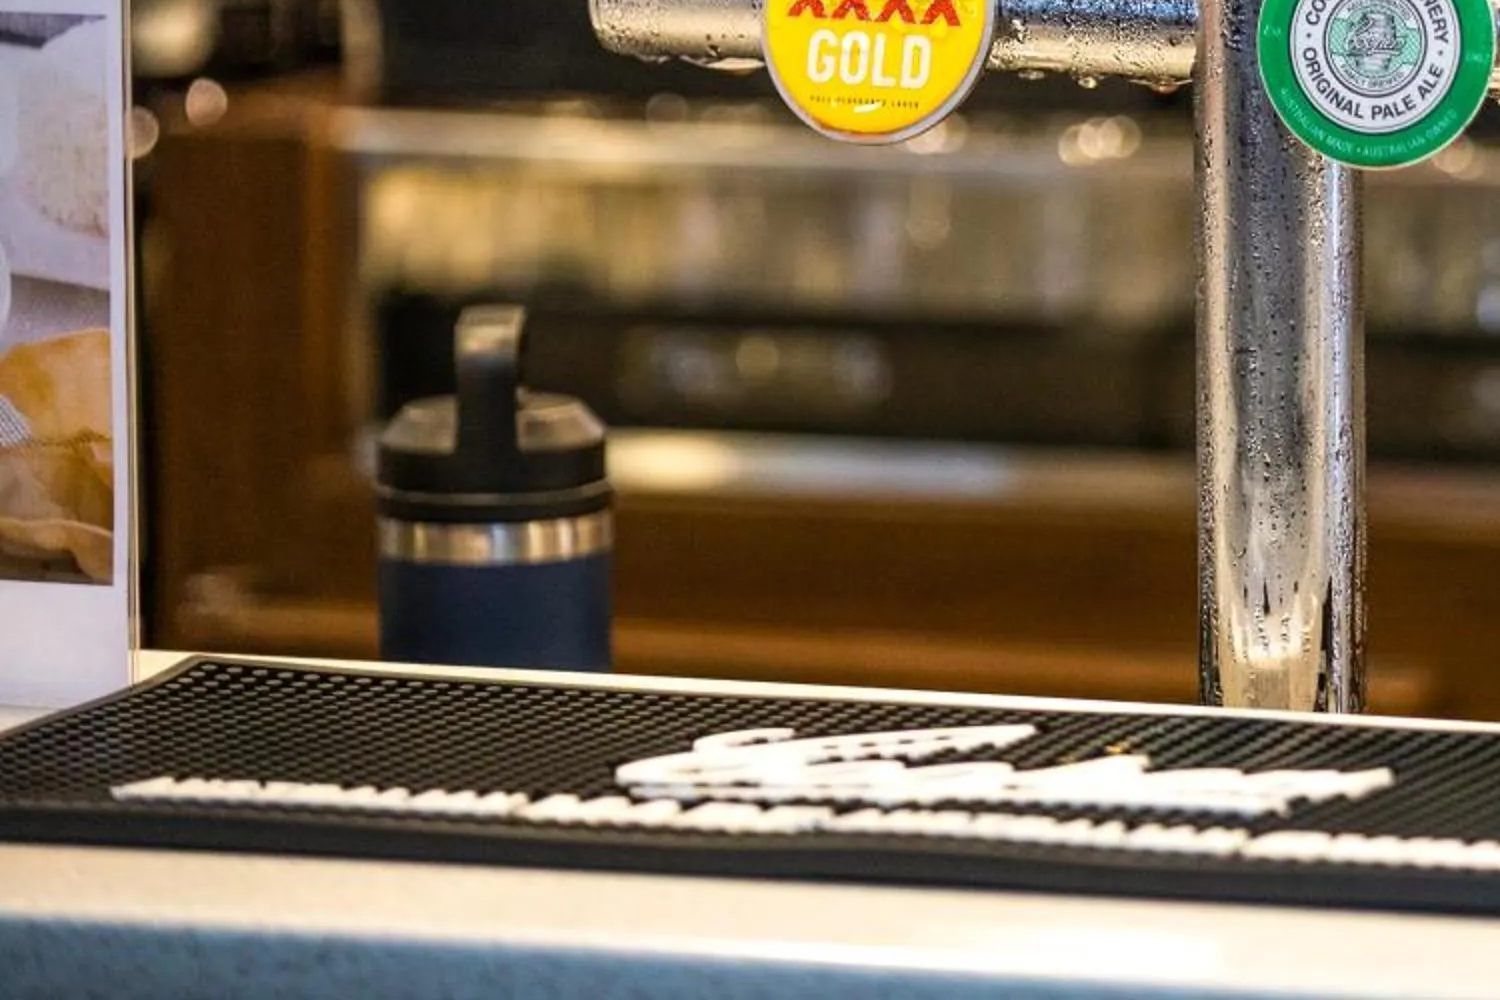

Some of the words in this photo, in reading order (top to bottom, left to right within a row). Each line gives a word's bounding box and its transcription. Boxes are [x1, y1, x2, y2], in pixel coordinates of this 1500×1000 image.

[807, 29, 932, 90] GOLD
[1303, 47, 1365, 120] ORIGINAL
[1371, 92, 1417, 121] PALE
[1418, 65, 1444, 100] ALE
